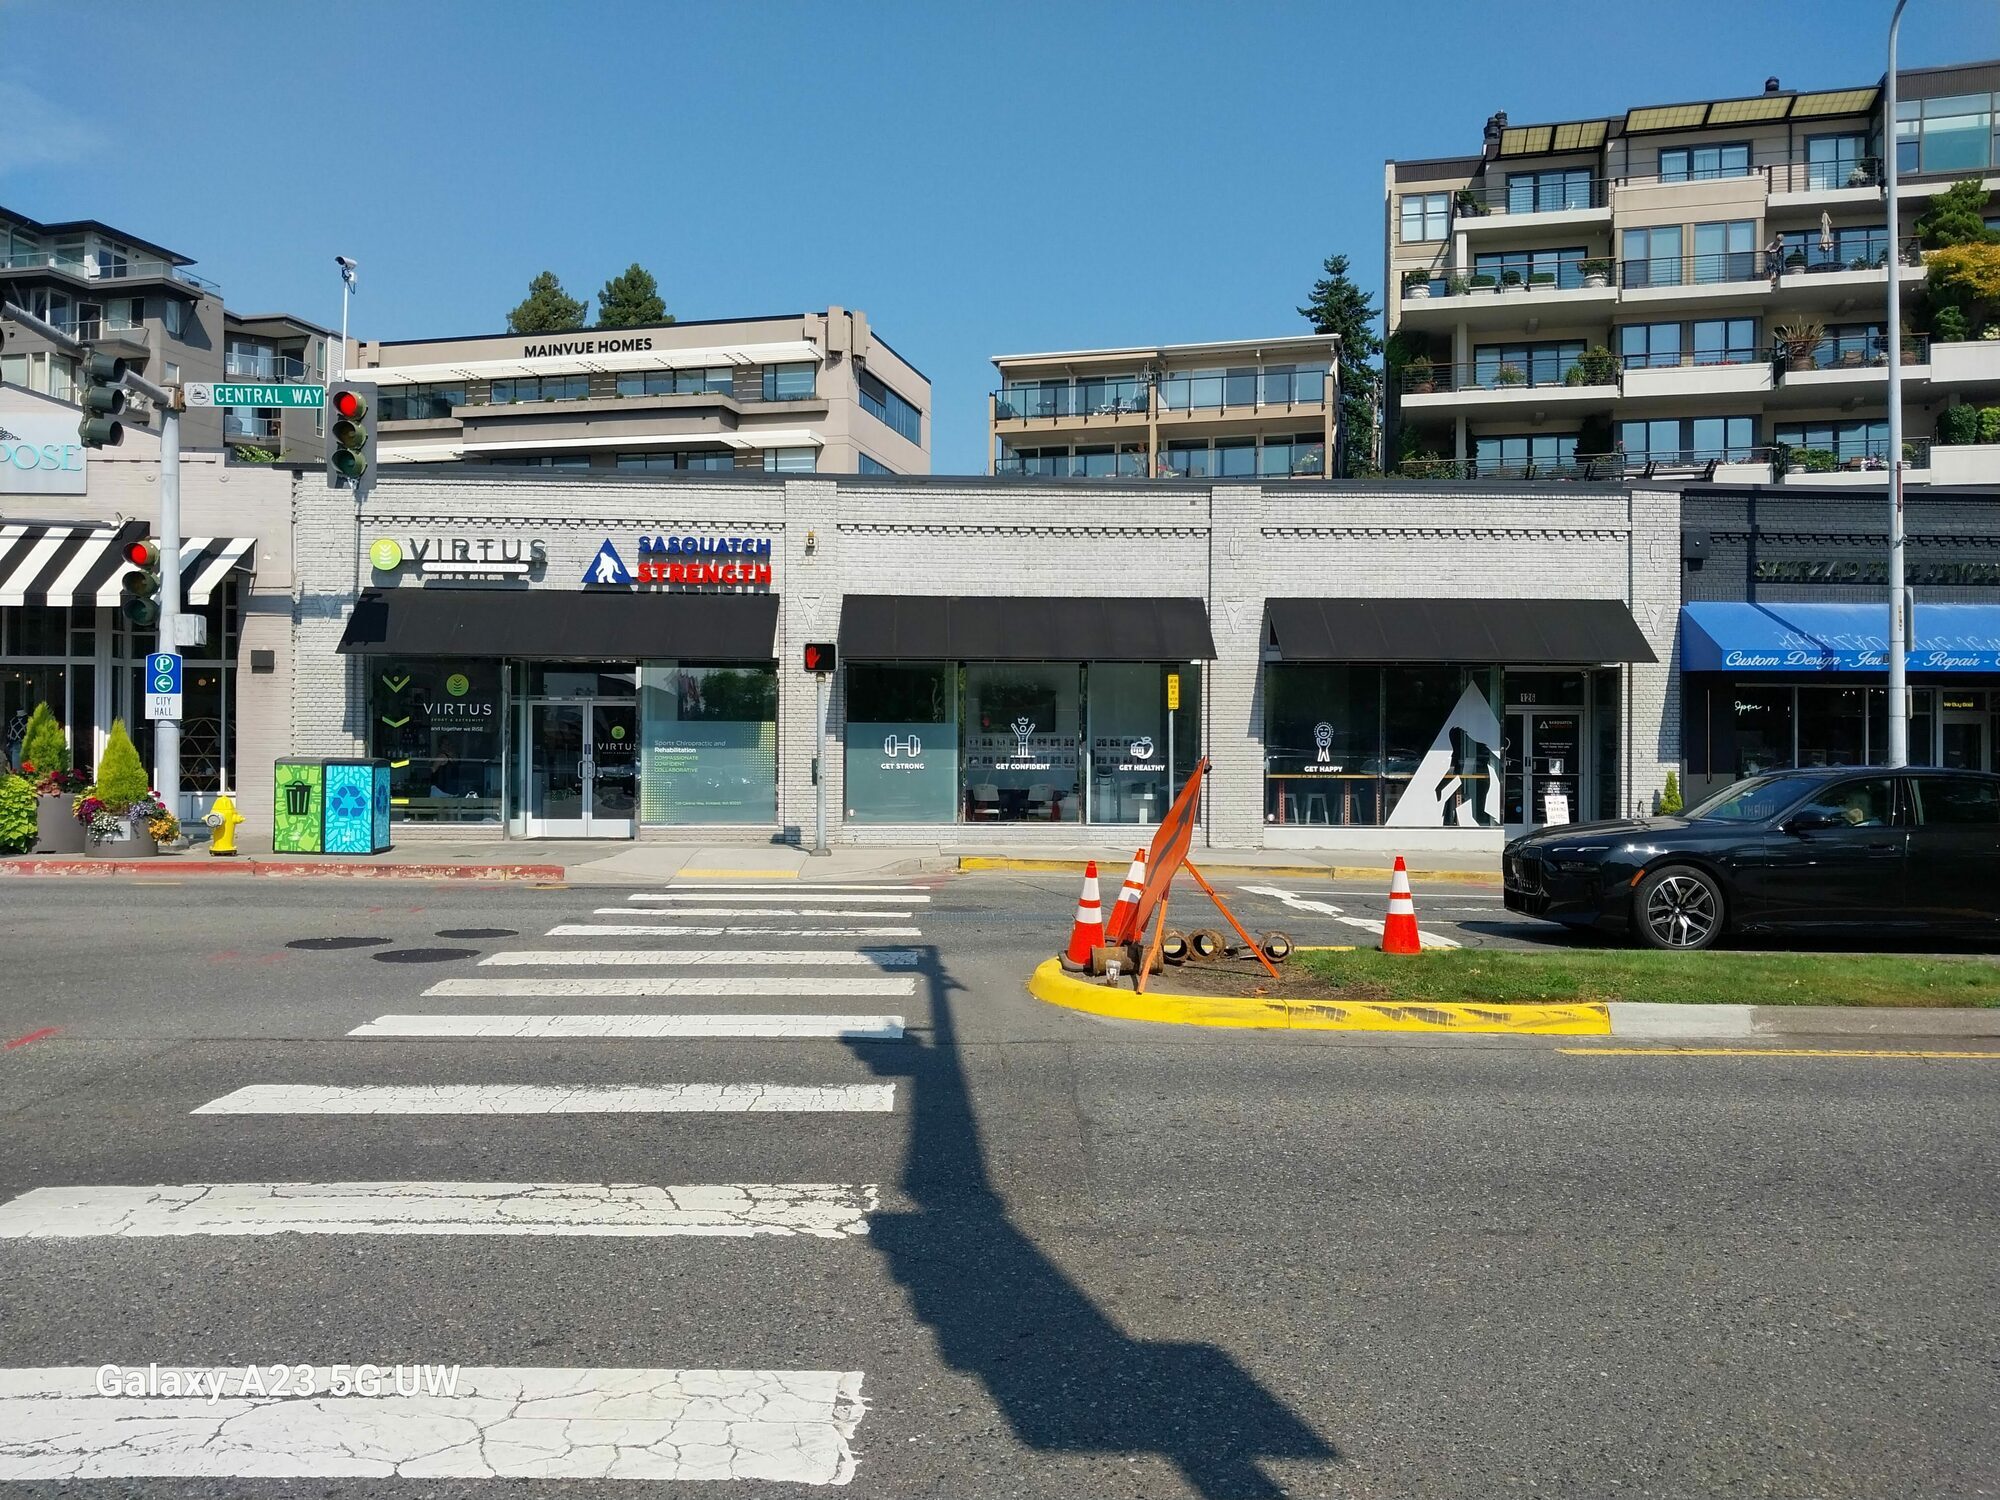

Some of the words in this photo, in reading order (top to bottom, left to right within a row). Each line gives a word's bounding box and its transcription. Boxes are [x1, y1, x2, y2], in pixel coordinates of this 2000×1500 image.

[524, 341, 594, 358] MAINVUE
[598, 338, 652, 353] HOMES
[215, 388, 283, 403] CENTRAL
[292, 388, 321, 404] WAY
[409, 538, 547, 561] VIRTUS
[639, 536, 771, 556] SASQUATCH
[638, 562, 771, 584] STRENGTH
[1725, 650, 1781, 666] Custom
[1784, 650, 1842, 670] Design
[1923, 651, 1980, 670] Repair
[155, 696, 172, 705] CITY
[423, 703, 492, 715] VIRTUS
[1734, 700, 1763, 716] Open
[154, 707, 173, 716] HALL
